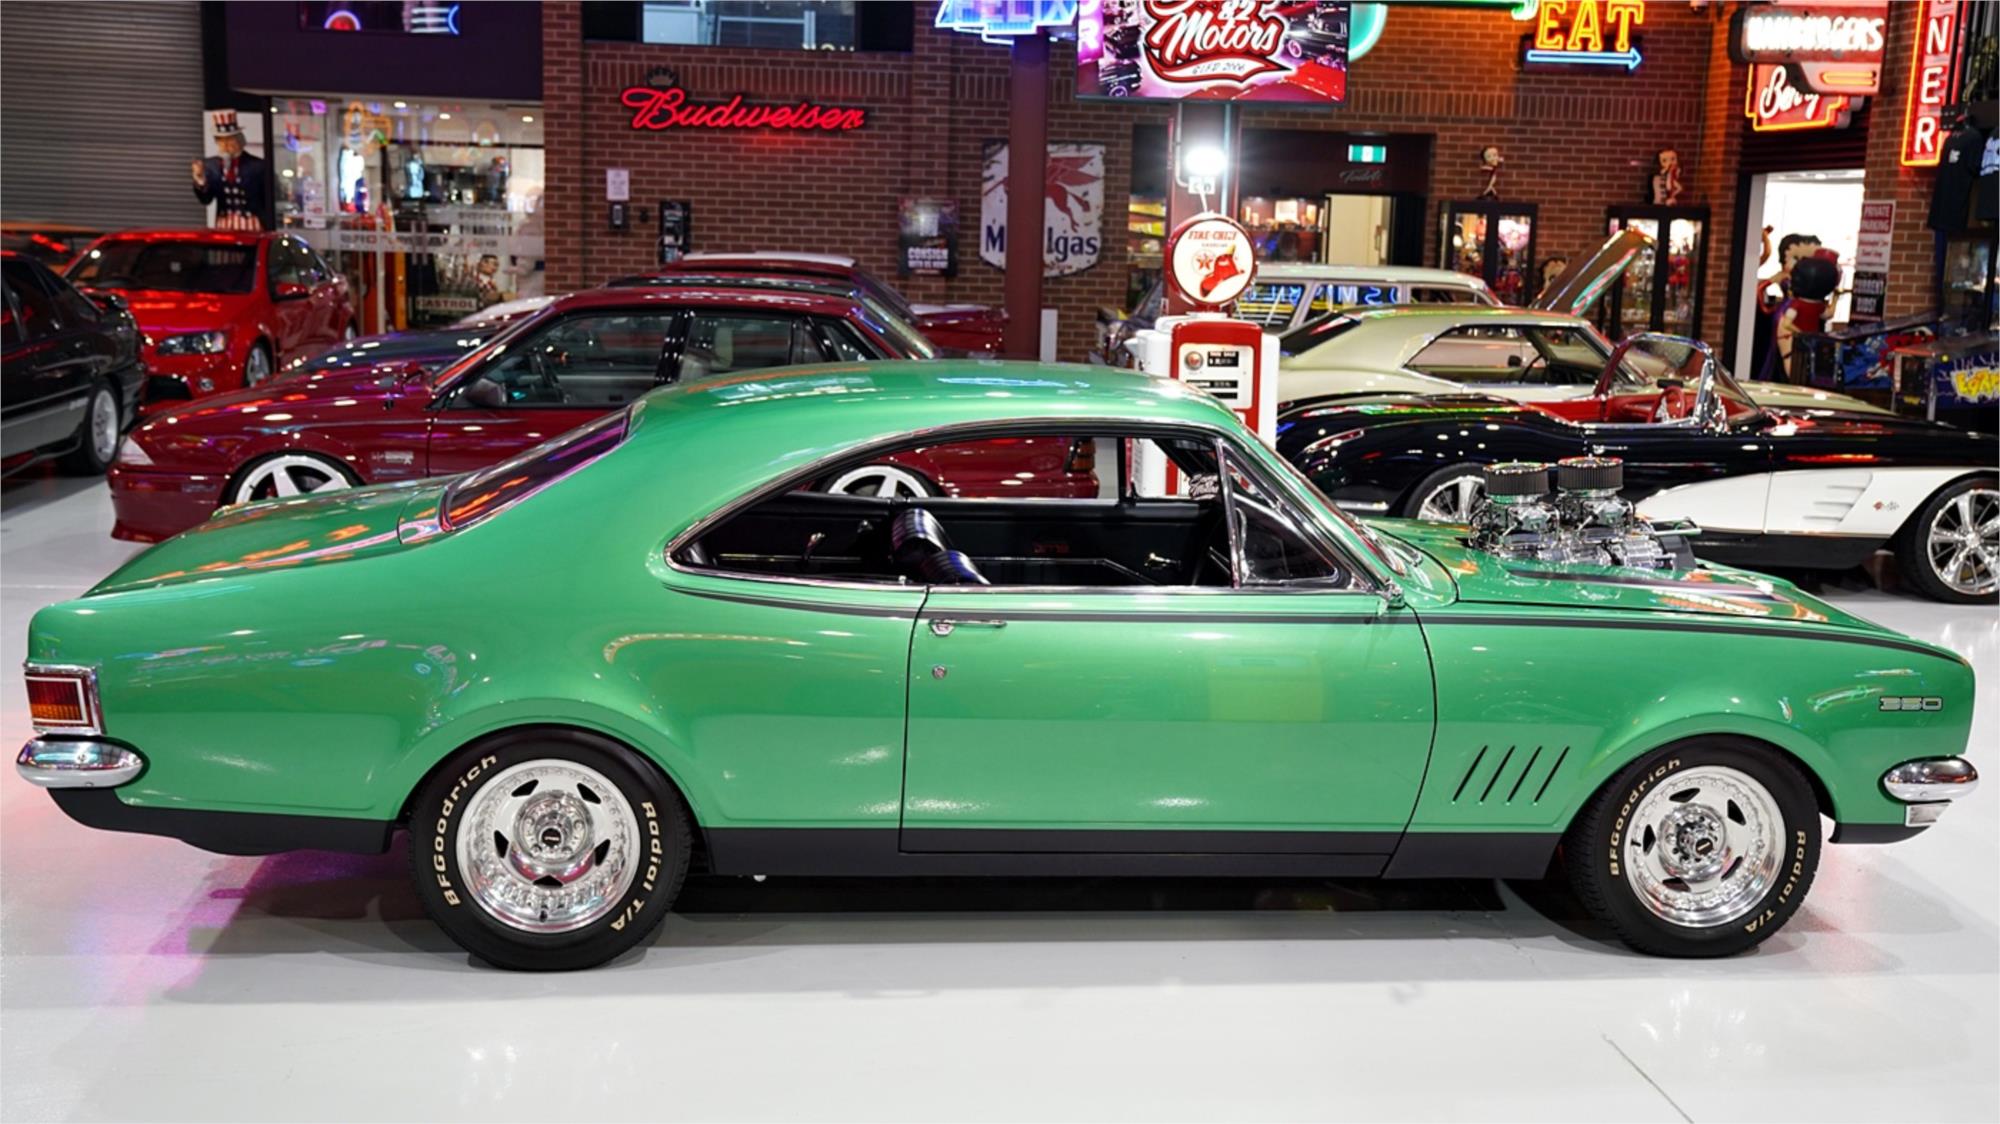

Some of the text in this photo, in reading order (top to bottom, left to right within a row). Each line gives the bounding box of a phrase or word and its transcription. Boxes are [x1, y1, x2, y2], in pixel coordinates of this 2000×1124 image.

[1151, 10, 1279, 63] Motors
[1535, 0, 1645, 52] EAT
[1914, 0, 1951, 153] NER
[621, 87, 866, 129] Budweiser
[985, 225, 1098, 262] Mlgas
[433, 754, 497, 907] BFGoodrich
[610, 801, 662, 932] Radial T/A
[1608, 758, 1682, 876] BFGoodrich
[1745, 830, 1807, 934] Radial T/A
